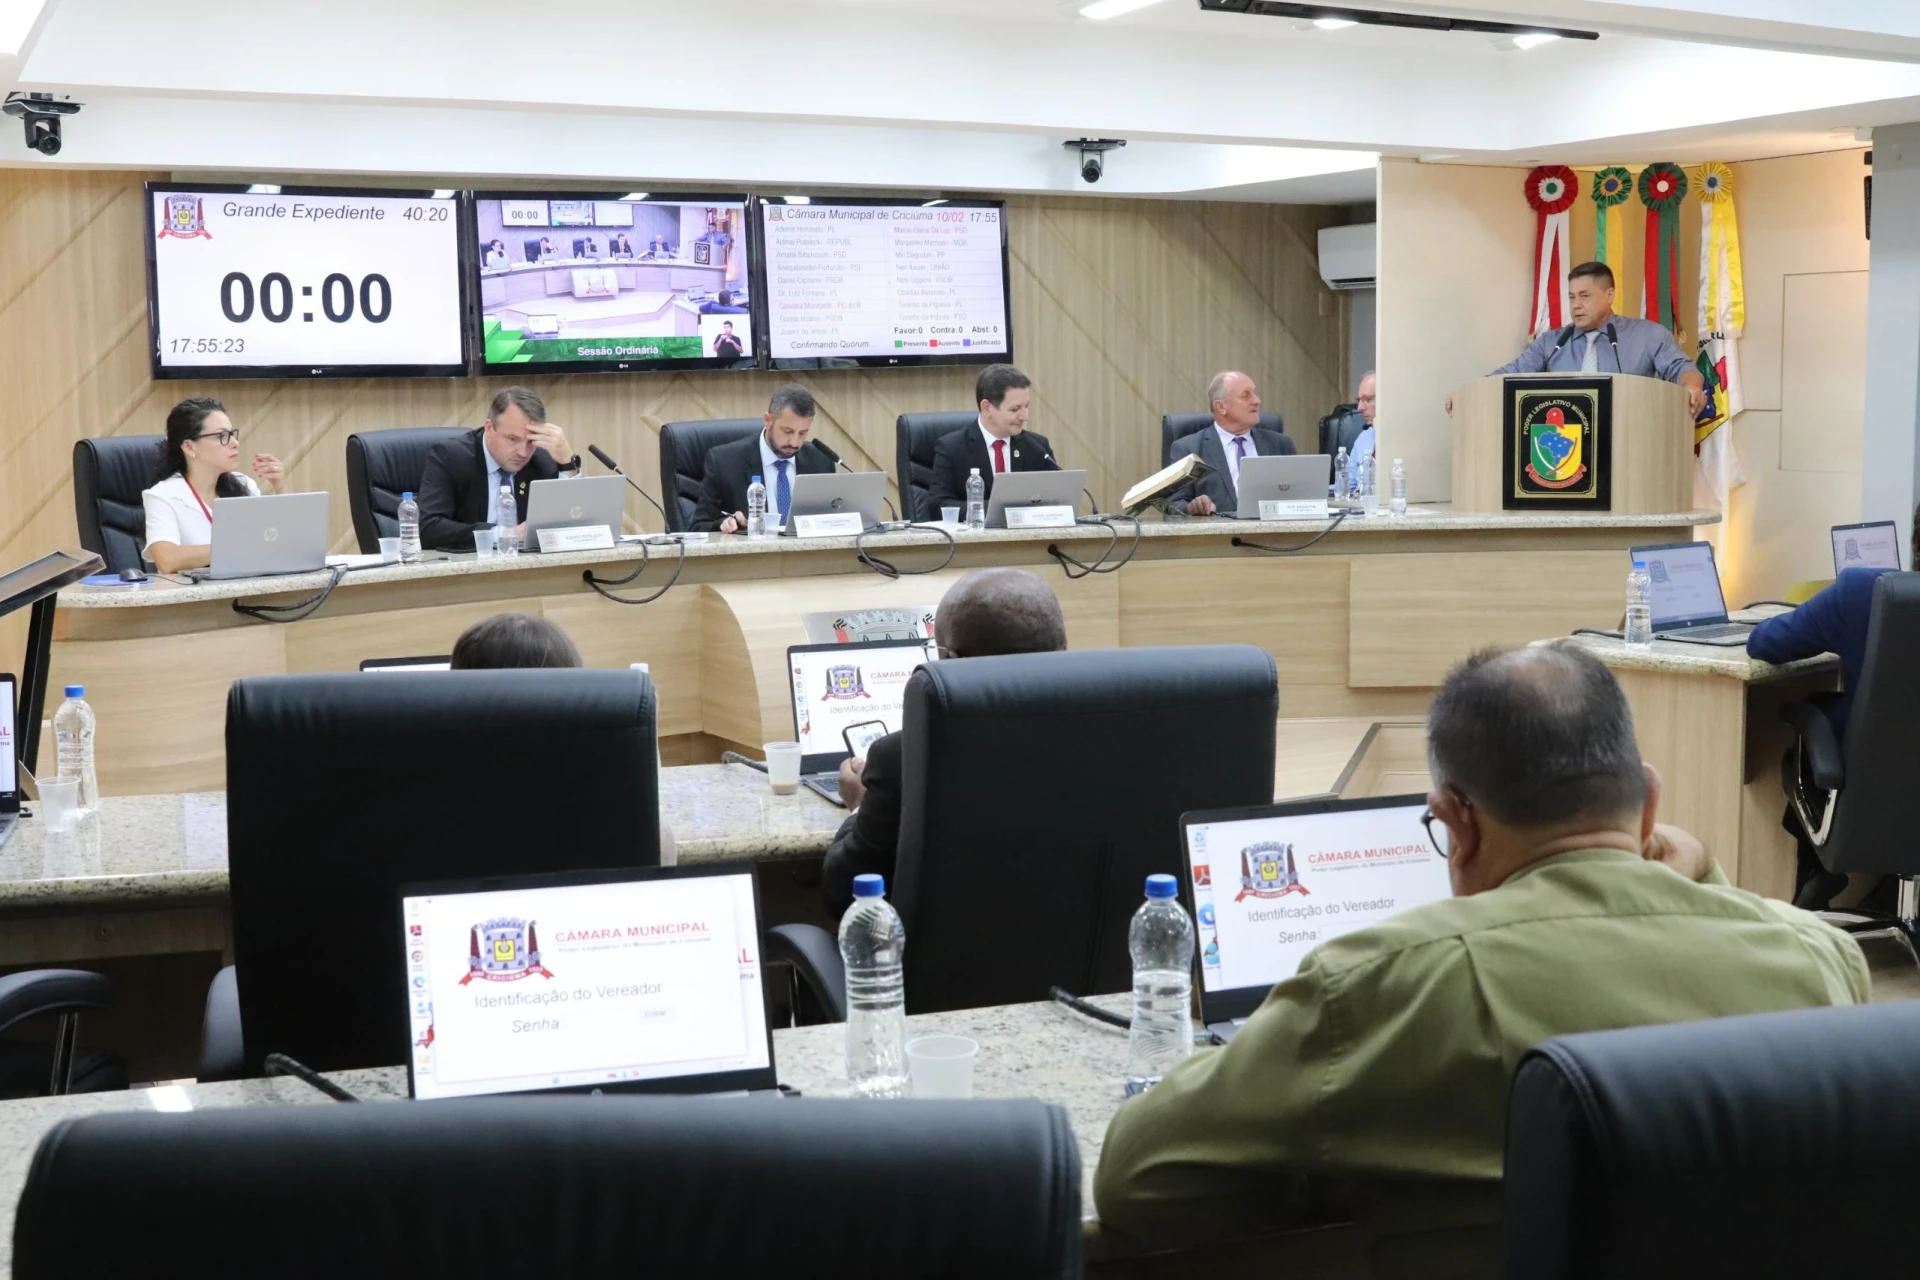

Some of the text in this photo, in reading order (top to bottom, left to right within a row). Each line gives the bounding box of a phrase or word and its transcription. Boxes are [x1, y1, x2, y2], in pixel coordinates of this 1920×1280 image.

[223, 202, 385, 222] Grande Expediente
[403, 207, 448, 221] 40:20
[512, 210, 538, 220] 00:00
[787, 208, 826, 219] Câmara
[829, 209, 874, 221] Municipal
[878, 210, 888, 220] de
[936, 212, 997, 222] 10/02 17:55
[220, 272, 392, 324] 00:00
[171, 338, 244, 353] 17:55:23
[578, 344, 658, 356] Sessão Ordinária
[791, 340, 838, 348] Confirmando
[1524, 400, 1590, 435] PODER LEGISLATIVO MUNICIPAL
[830, 702, 879, 714] Identificação
[882, 702, 891, 710] do
[1308, 844, 1430, 864] CÂMARA MUNICIPAL
[1248, 897, 1396, 923] Identificação do Vereador
[555, 922, 710, 943] CÂMARA MUNICIPAL
[474, 982, 662, 1009] Identificação do Vereador
